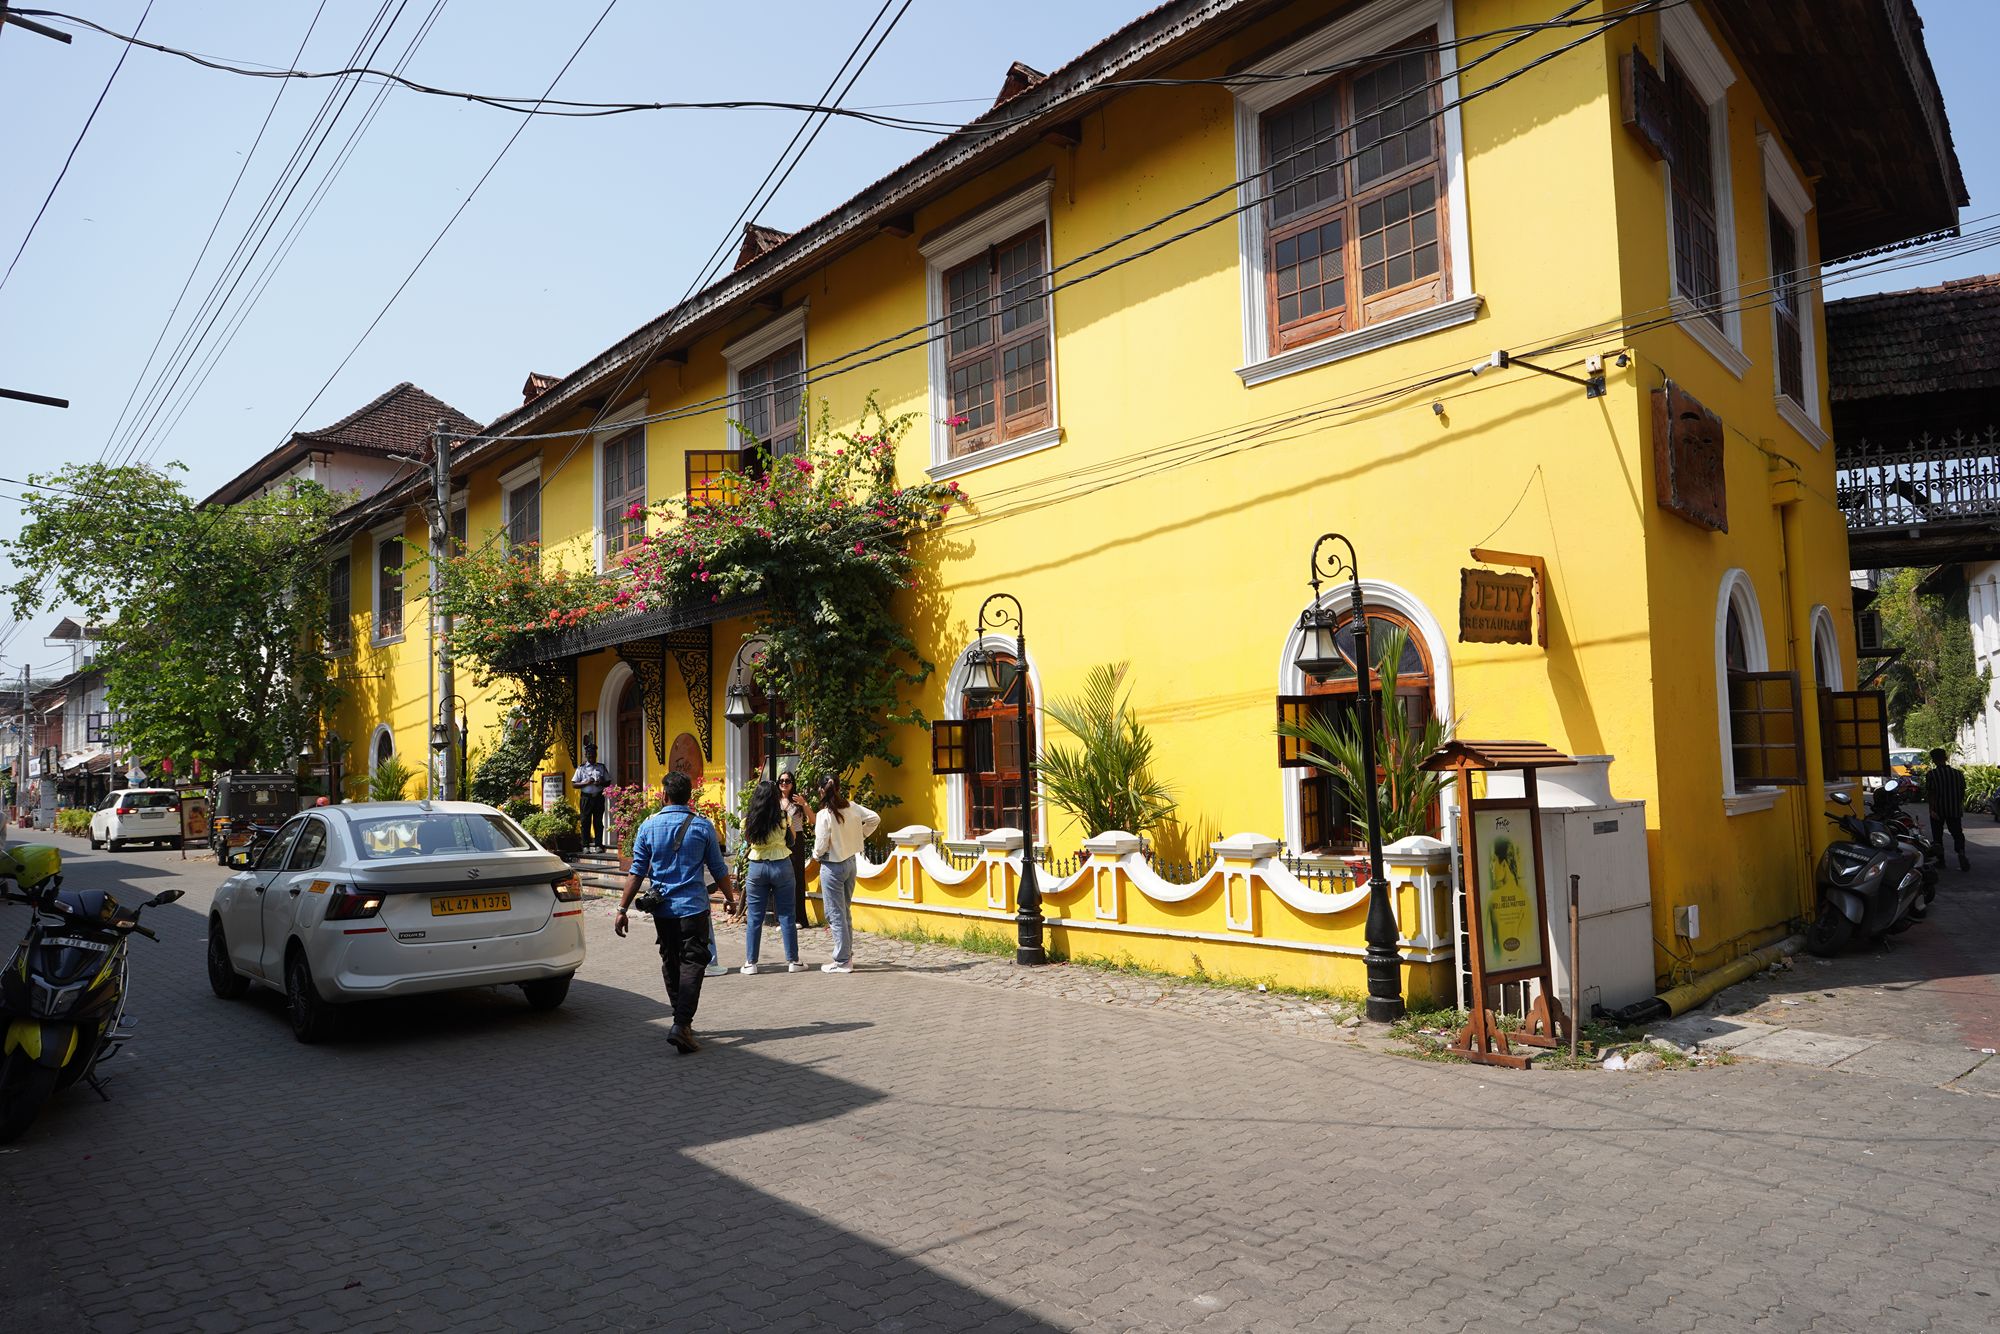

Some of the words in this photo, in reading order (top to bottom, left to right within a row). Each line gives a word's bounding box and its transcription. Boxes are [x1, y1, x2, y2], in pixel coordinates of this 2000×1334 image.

[1470, 580, 1526, 612] JETTY
[1465, 616, 1529, 631] RESTAURANT
[440, 900, 453, 912] KL
[457, 898, 468, 911] 47
[472, 898, 480, 910] N
[482, 896, 508, 908] 1376
